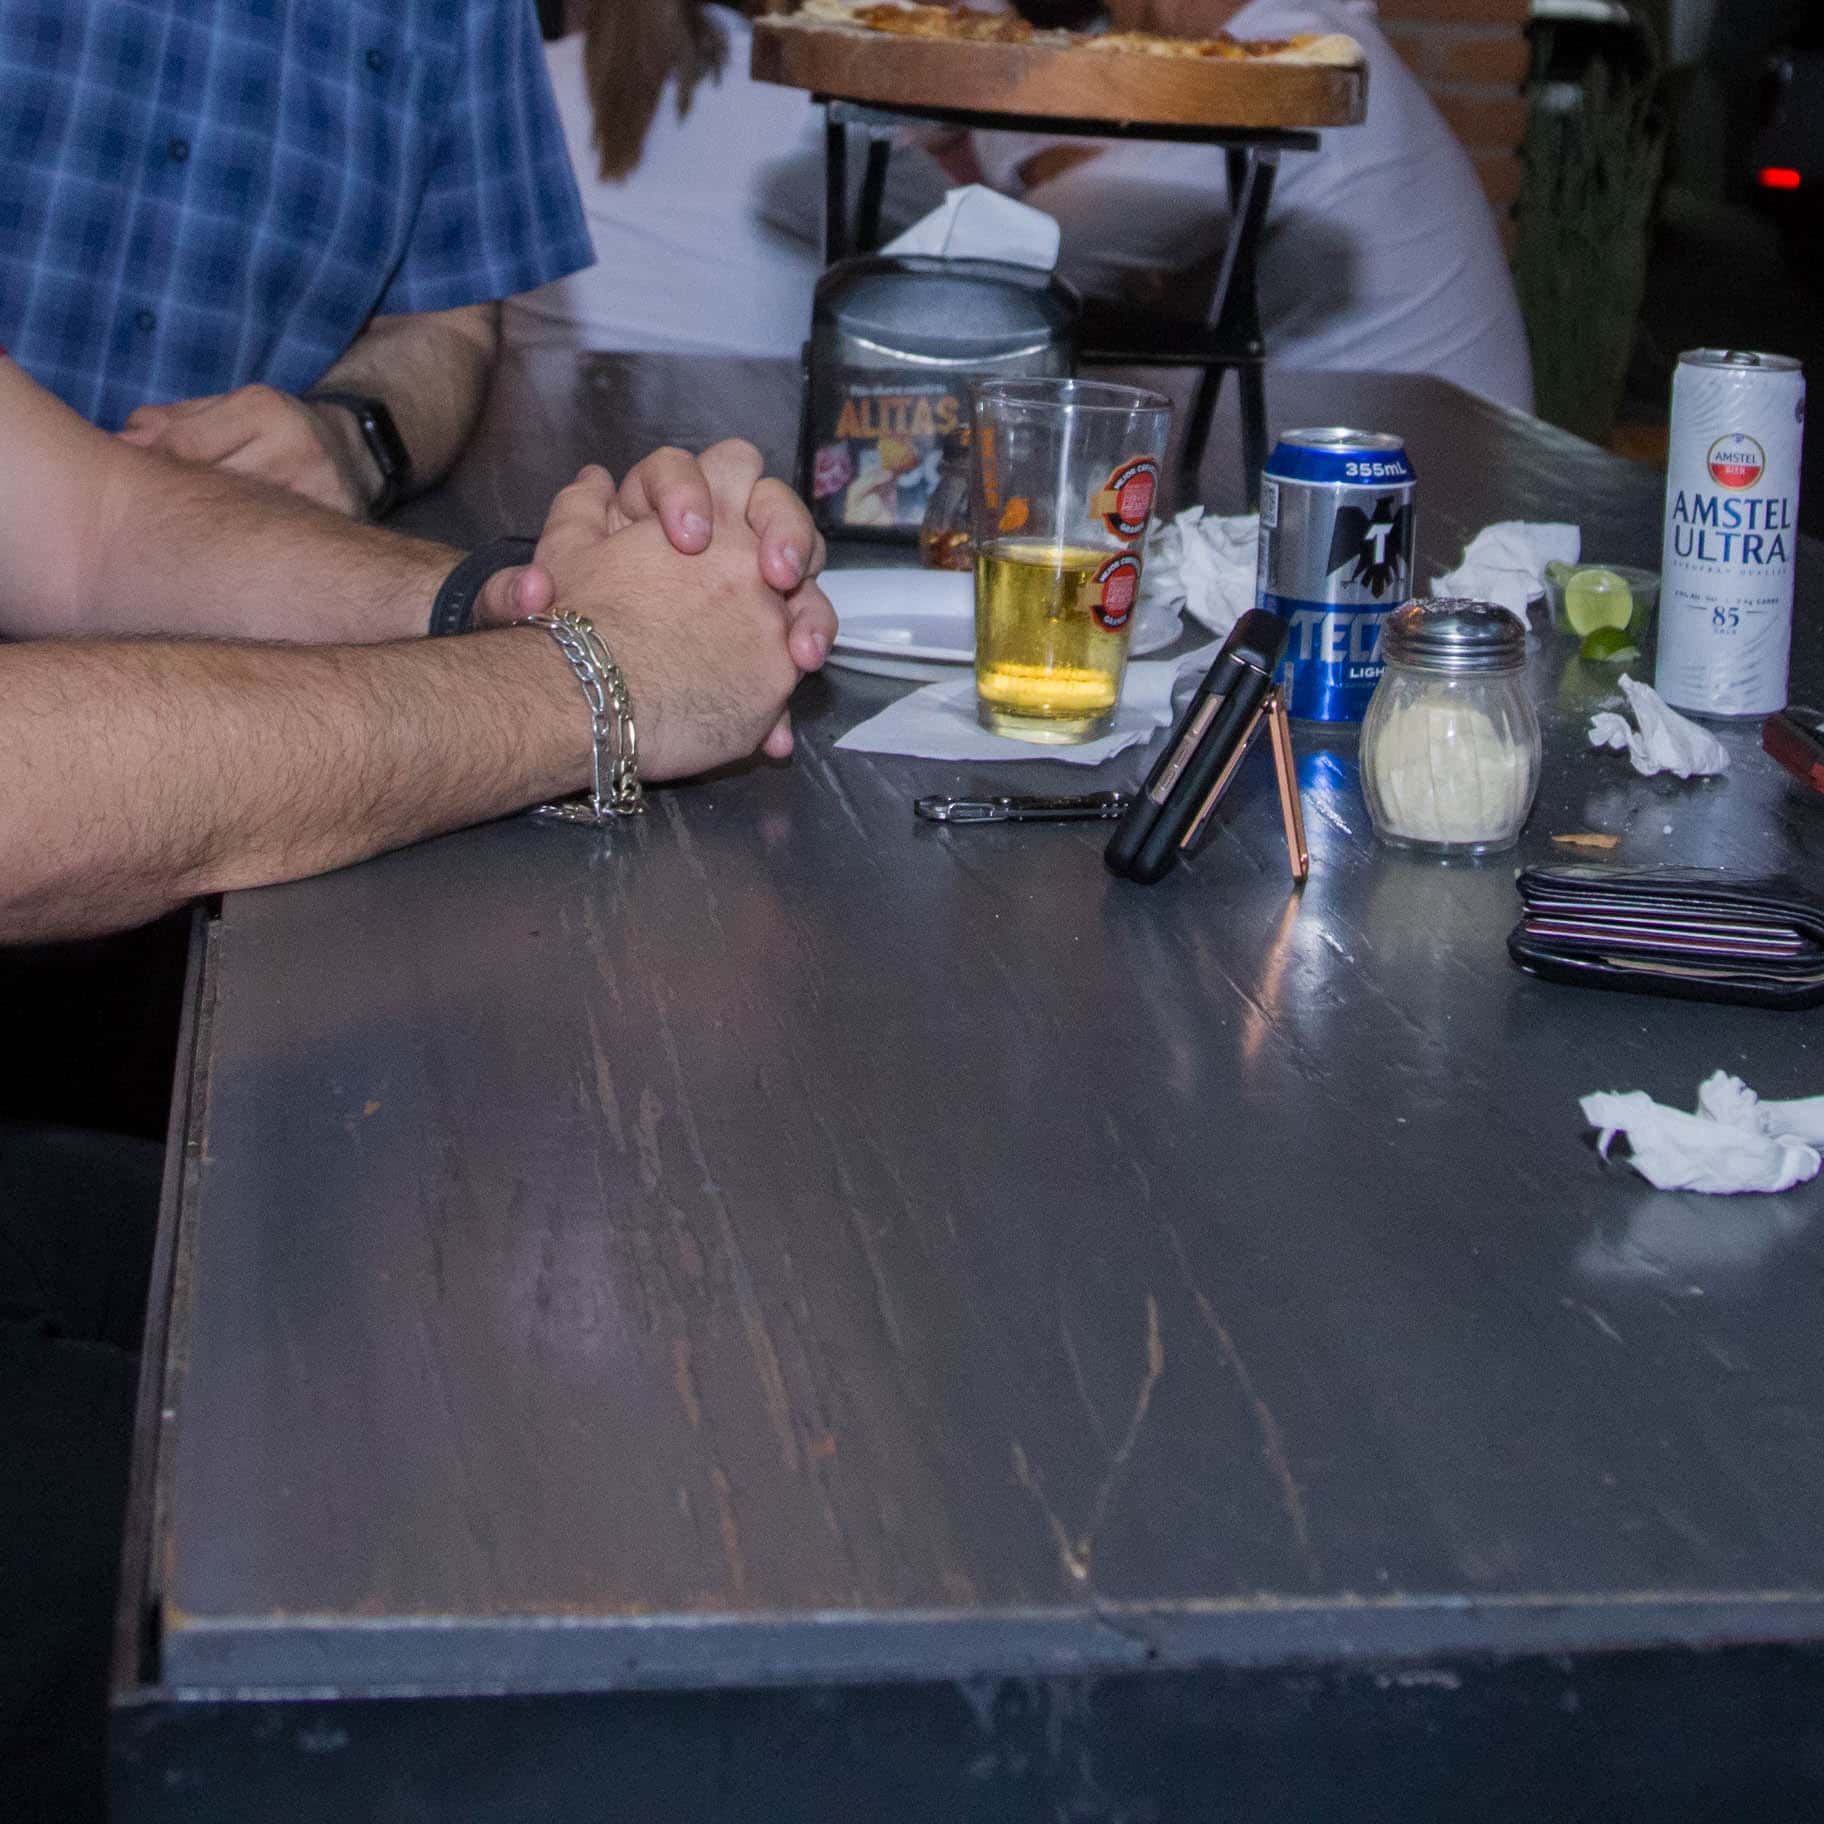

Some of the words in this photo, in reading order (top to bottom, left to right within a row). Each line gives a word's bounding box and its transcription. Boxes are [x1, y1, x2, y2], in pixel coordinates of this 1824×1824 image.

[834, 395, 960, 440] ALITAS
[1345, 461, 1408, 477] 355mL
[1714, 451, 1758, 464] AMSTEL
[1673, 490, 1792, 530] AMSTEL
[1674, 524, 1787, 565] ULTRA
[1711, 605, 1740, 628] 85
